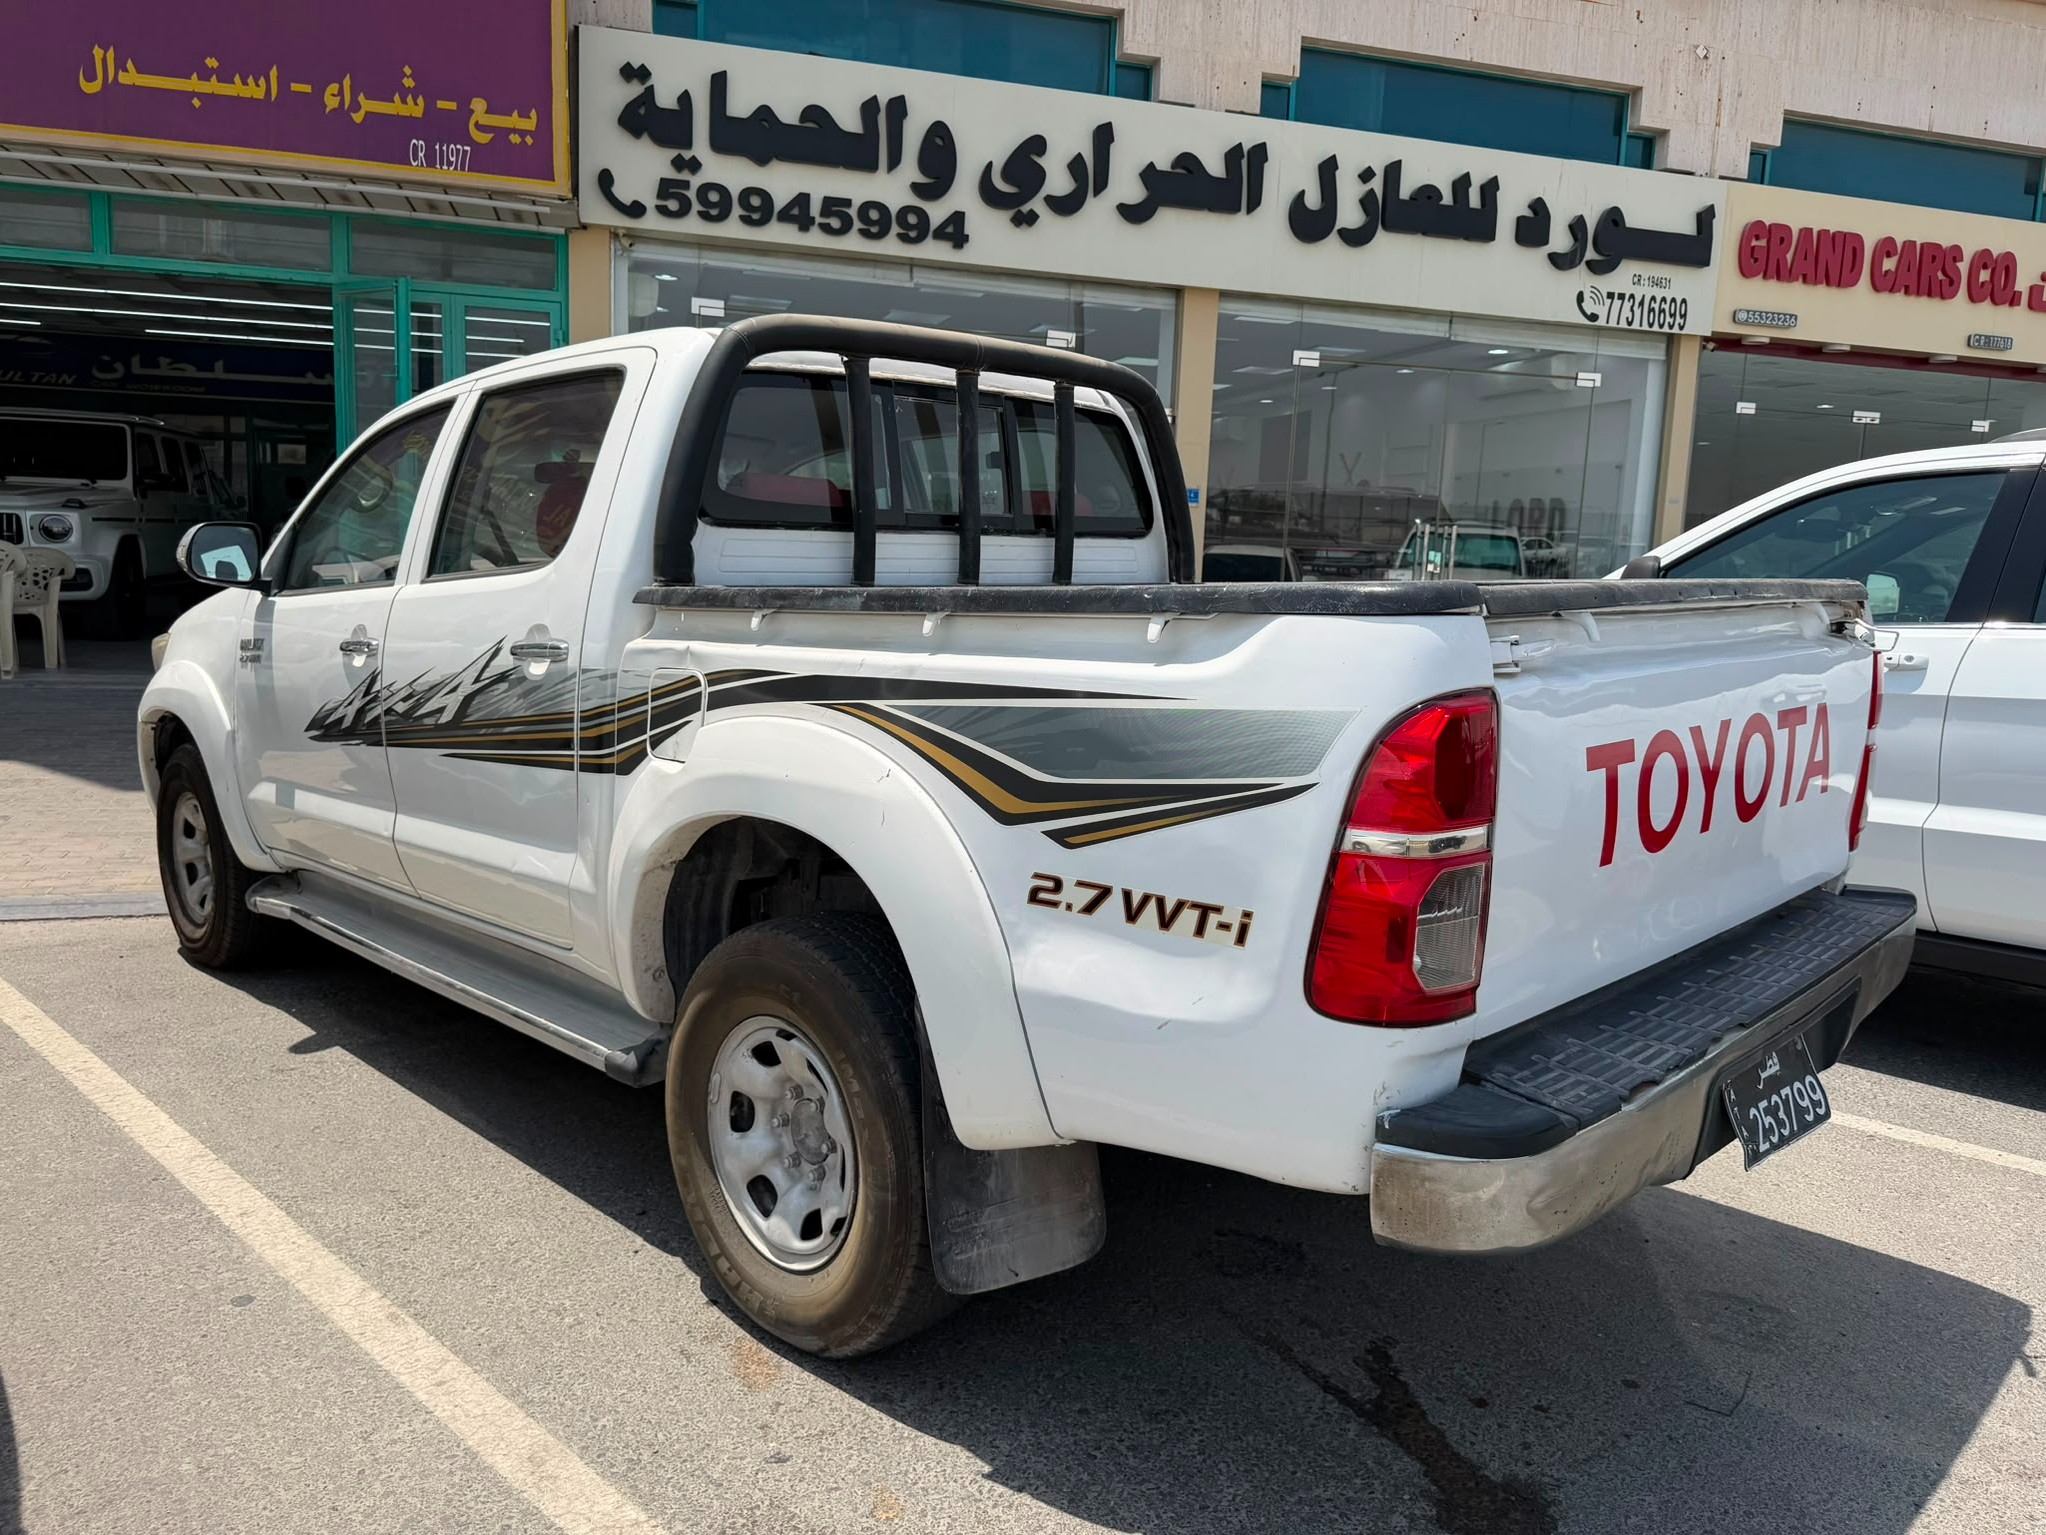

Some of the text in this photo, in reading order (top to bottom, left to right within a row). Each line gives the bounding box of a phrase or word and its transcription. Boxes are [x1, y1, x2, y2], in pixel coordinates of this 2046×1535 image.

[79, 44, 279, 109] استبدال
[323, 65, 425, 125] شراء
[468, 97, 538, 147] بيع
[409, 138, 471, 173] CR 11977
[616, 61, 1717, 276] لورد للعازل الحراري والحماية
[654, 176, 970, 250] 59945994
[1737, 218, 1865, 289] GRAND
[1870, 235, 1964, 301] CARS
[1966, 247, 2023, 308] CO.
[1605, 291, 1688, 331] 77316699
[1747, 311, 1797, 327] 55323236
[1585, 702, 1830, 868] TOYOTA
[1026, 871, 1255, 948] 2.7 VVT-i
[1756, 1051, 1781, 1090] قطر
[1749, 1073, 1827, 1153] 253799
